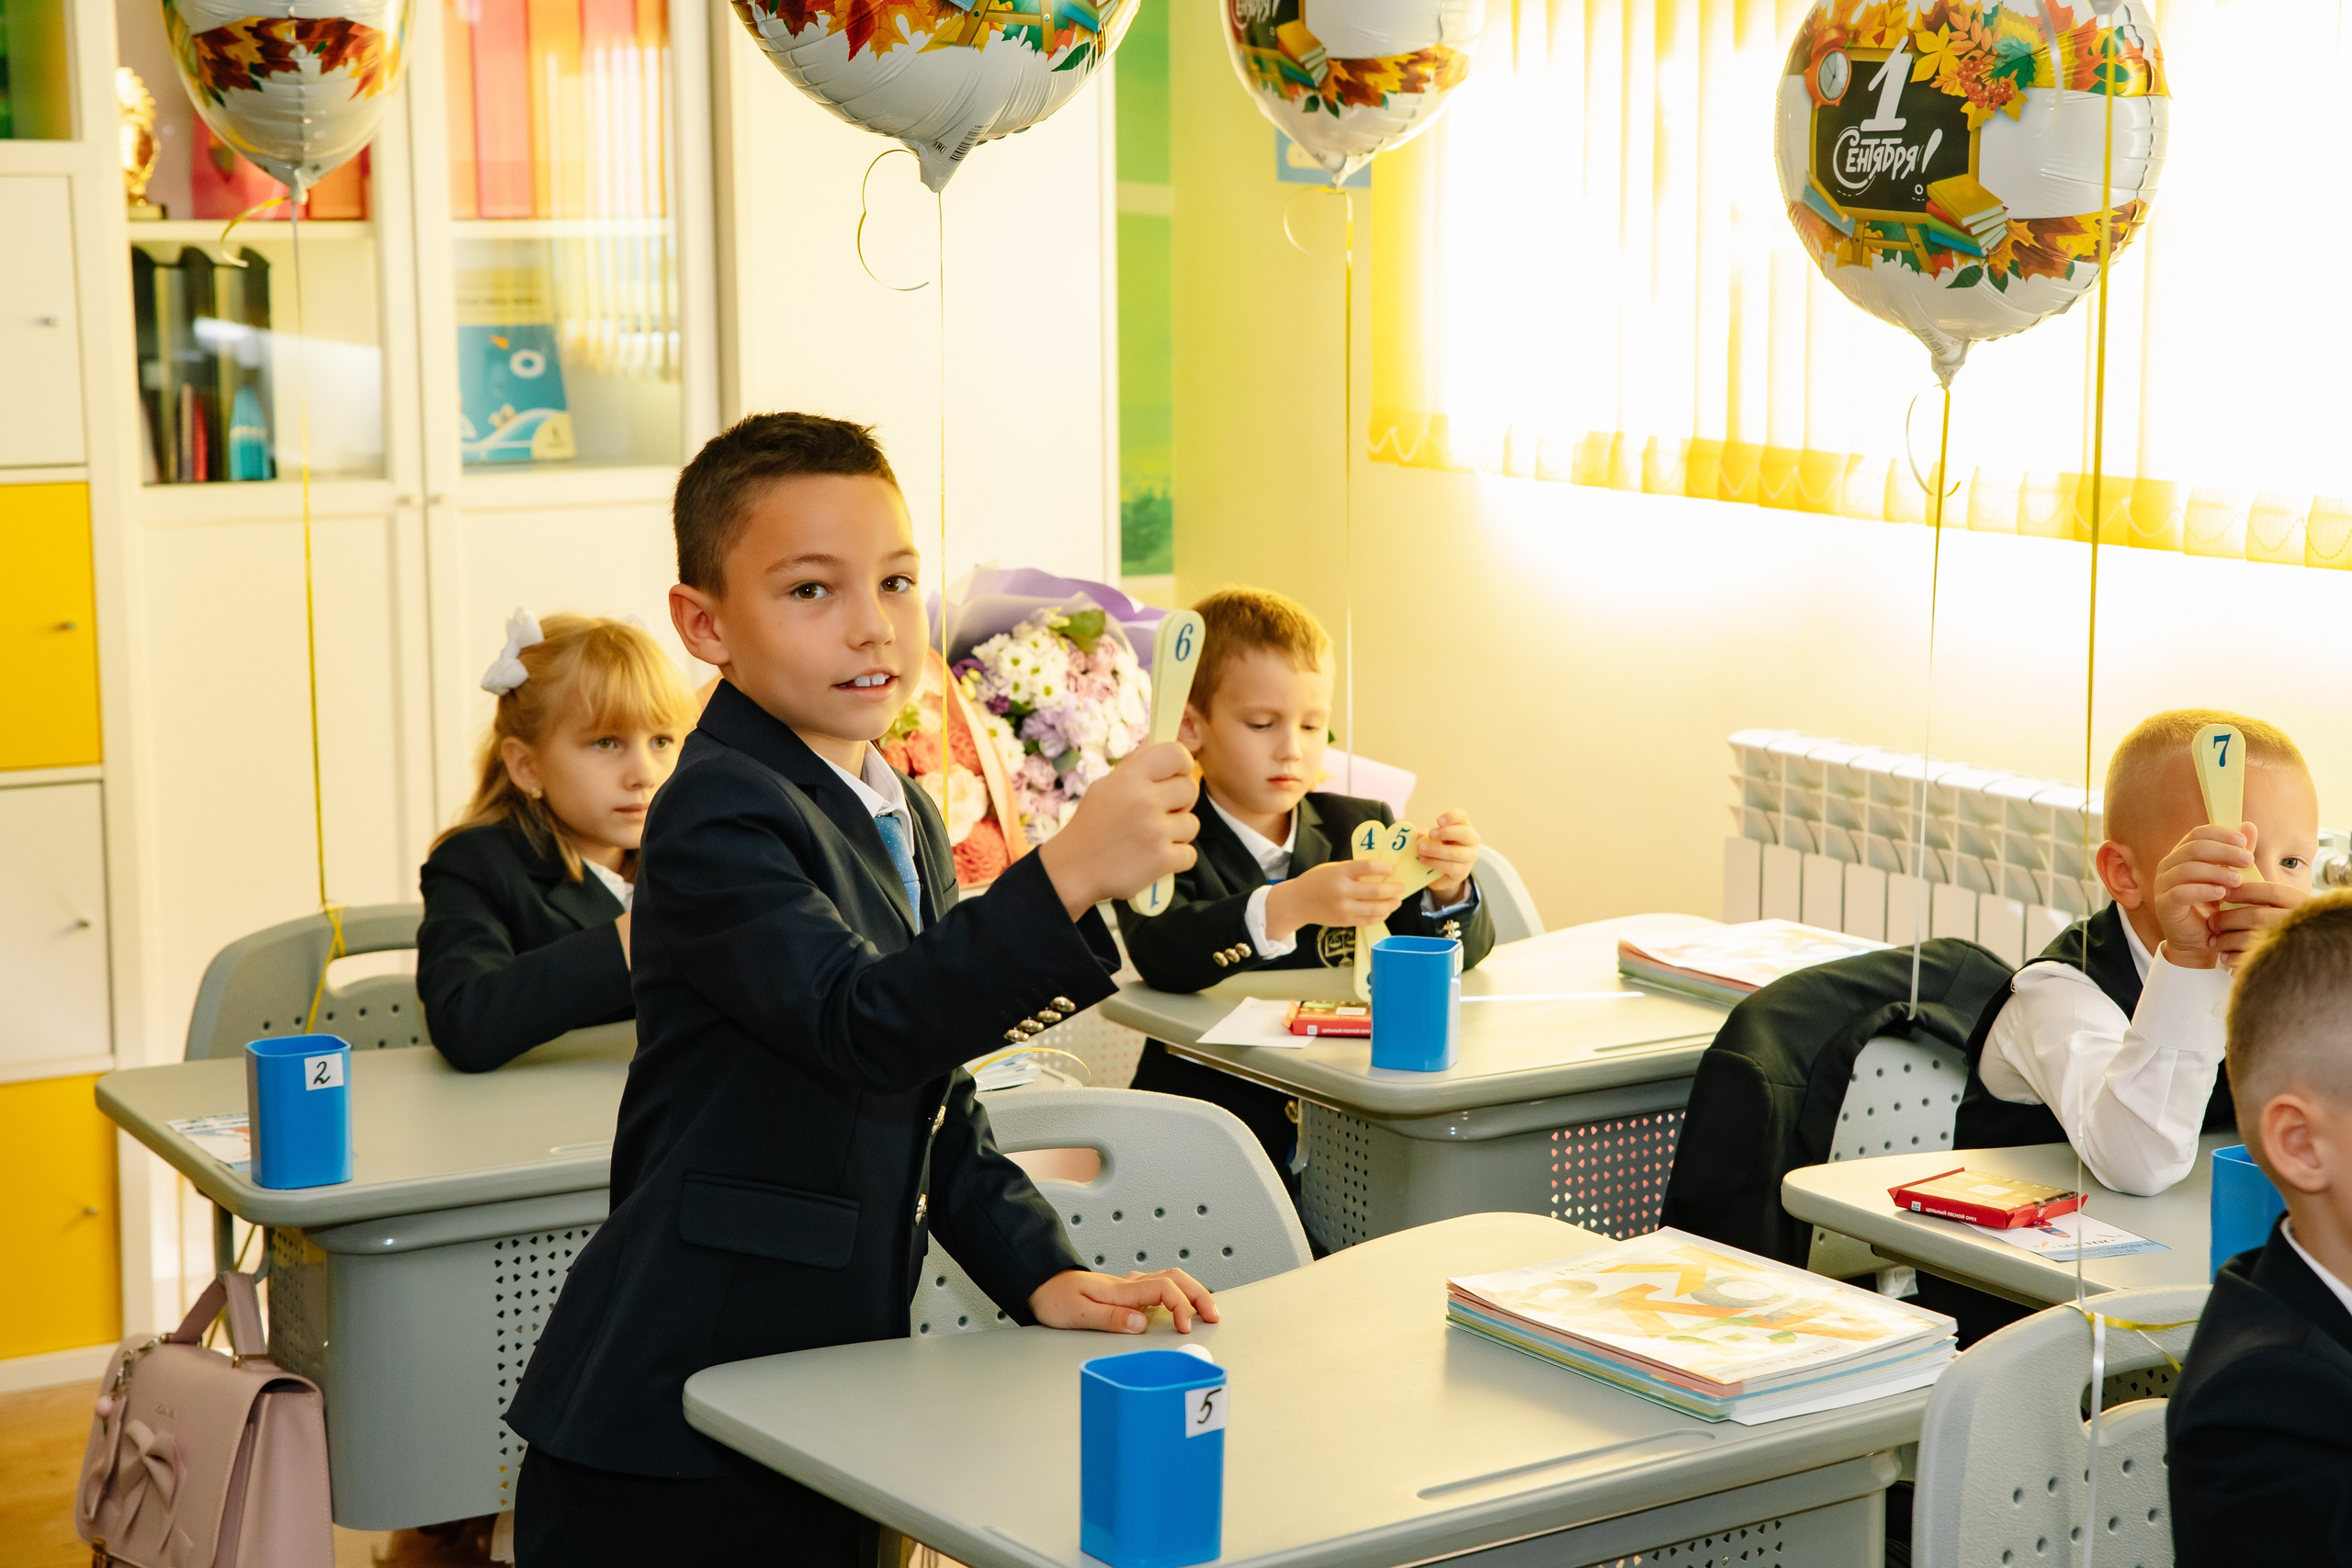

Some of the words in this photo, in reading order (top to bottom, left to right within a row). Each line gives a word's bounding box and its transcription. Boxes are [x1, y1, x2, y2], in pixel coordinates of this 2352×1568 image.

[1860, 35, 1914, 131] 1
[1175, 623, 1193, 661] 6
[2213, 733, 2232, 768] 7
[1360, 827, 1375, 851] 4
[1391, 828, 1411, 851] 5
[313, 1060, 331, 1085] 2
[1196, 1388, 1222, 1424] 5
